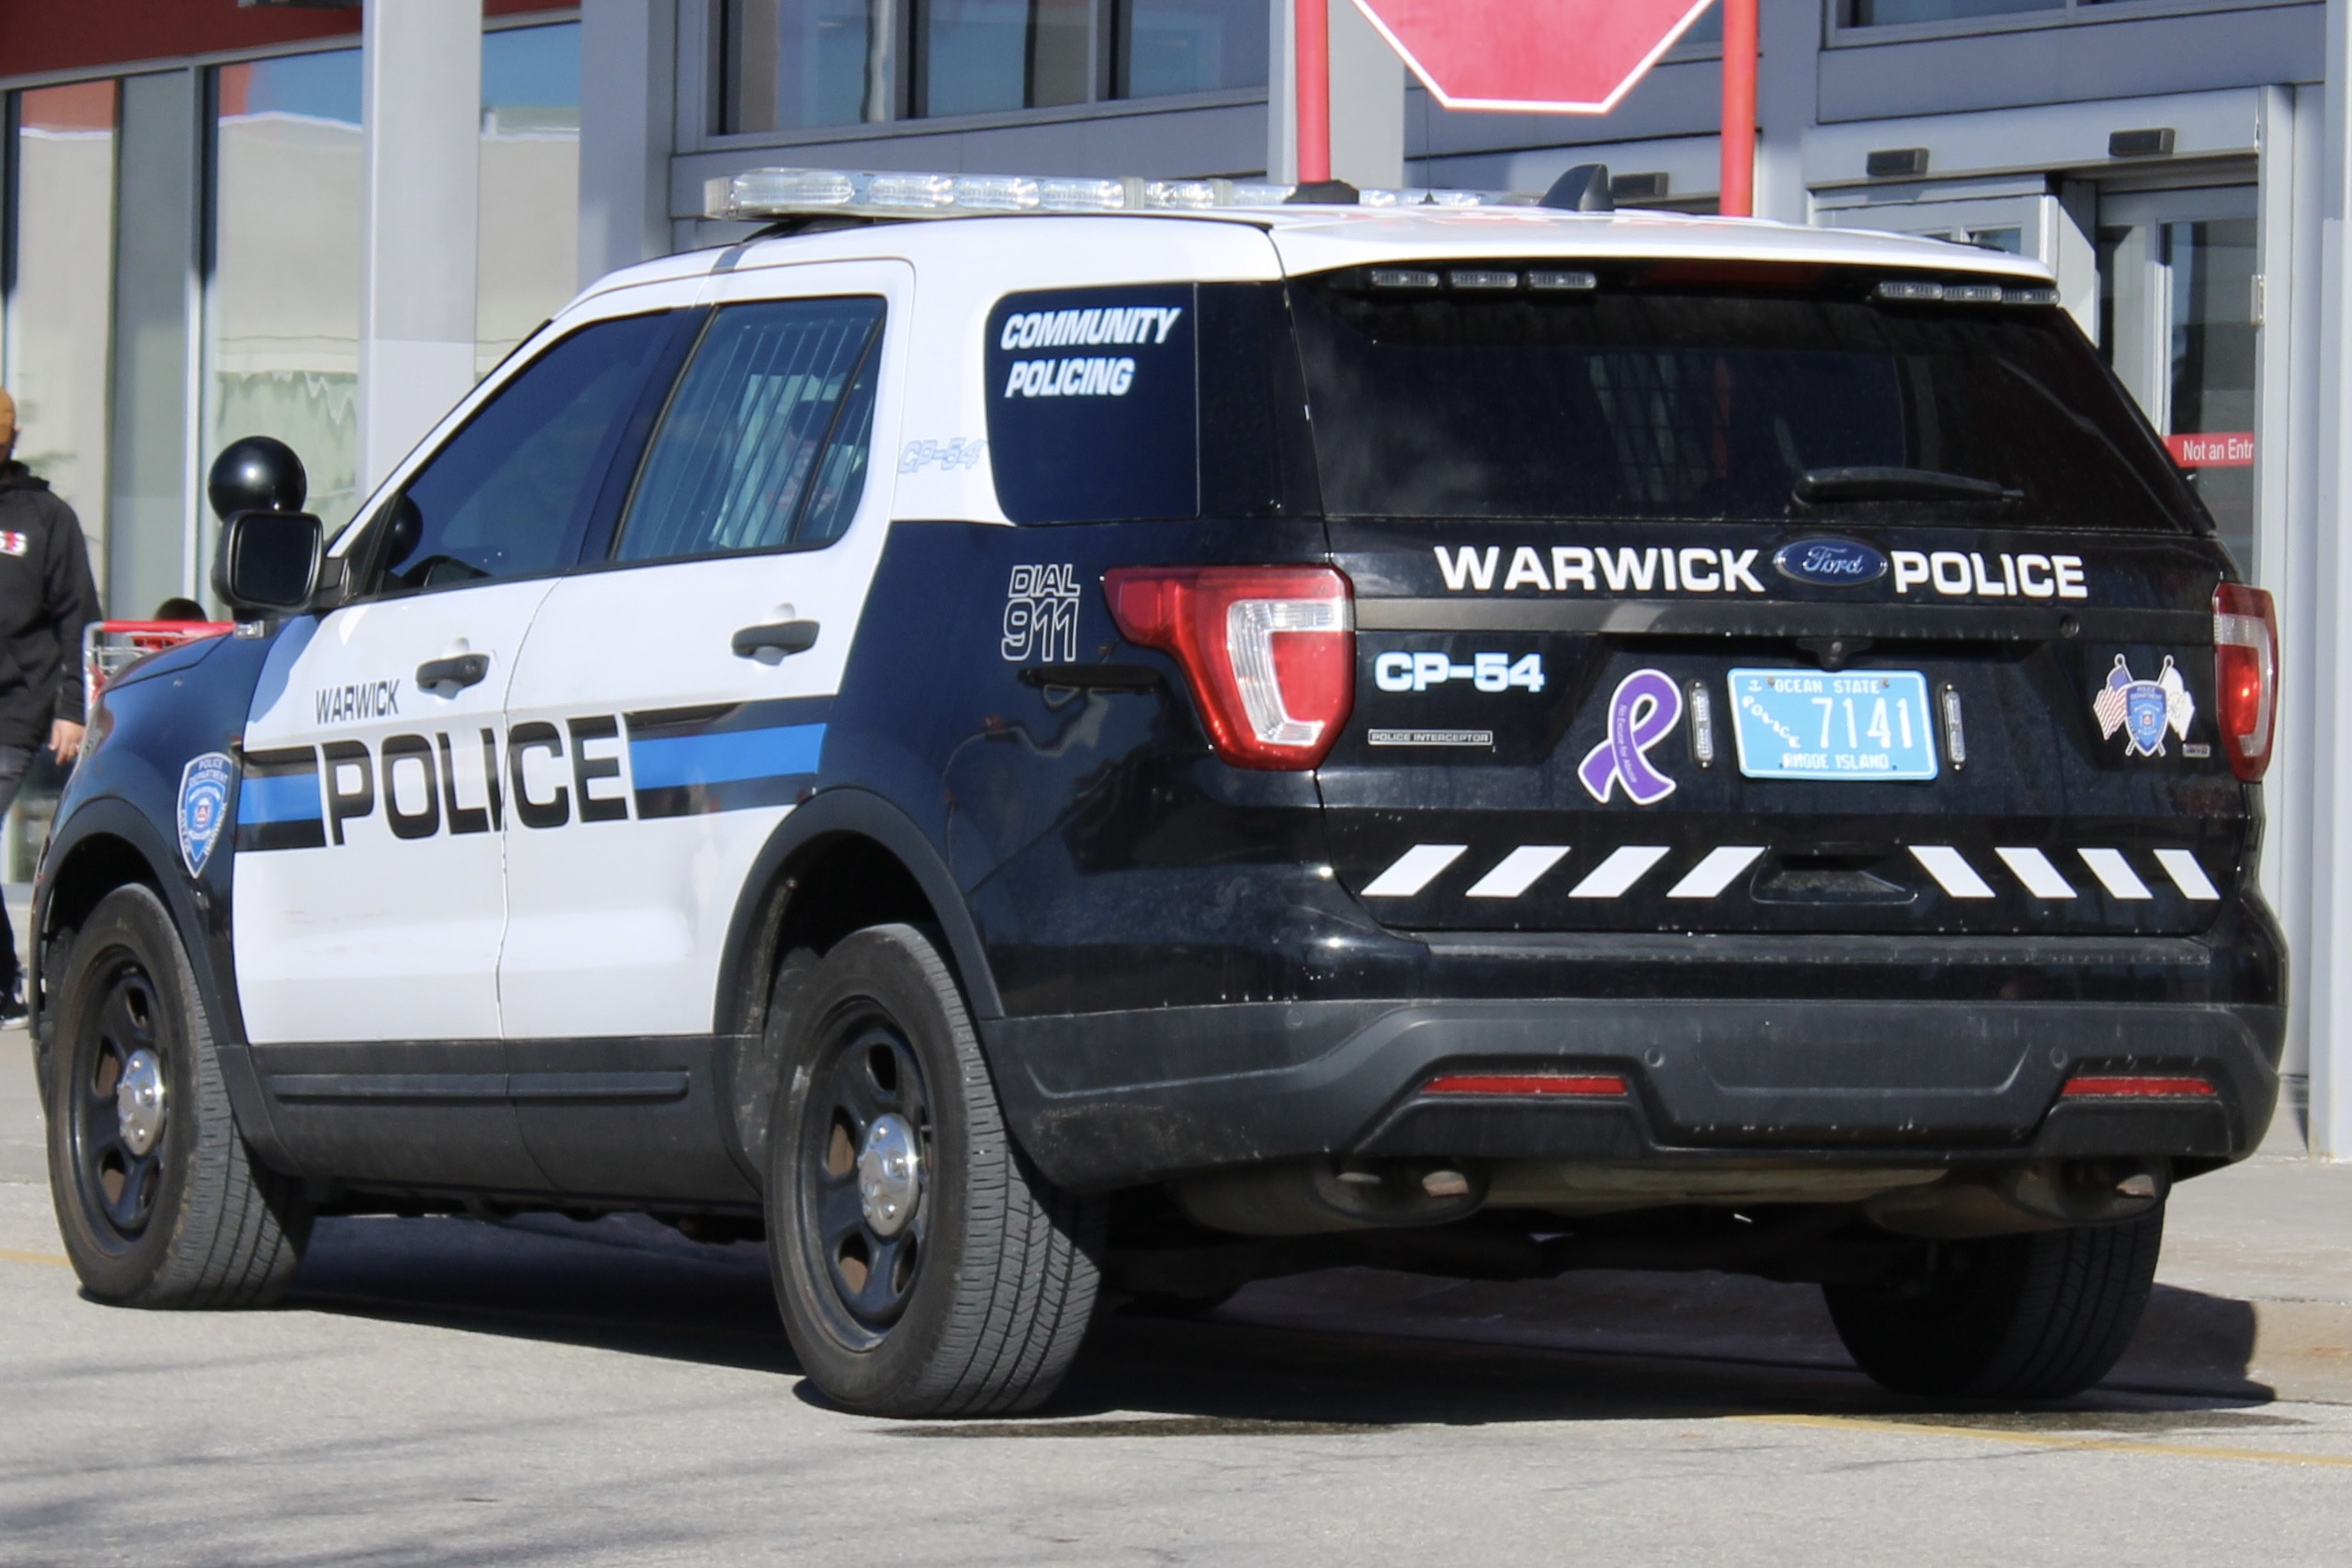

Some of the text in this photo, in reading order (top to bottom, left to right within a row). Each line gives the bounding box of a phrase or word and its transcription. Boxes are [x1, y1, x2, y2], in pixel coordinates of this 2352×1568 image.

[1000, 307, 1183, 350] COMMUNITY
[1004, 357, 1136, 398] POLICING
[898, 436, 988, 475] CP-54
[2183, 440, 2206, 462] Not
[2209, 442, 2225, 461] an
[1008, 564, 1081, 598] DIAL
[1433, 546, 1766, 593] WARWICK
[1802, 545, 1864, 576] Ford
[1890, 550, 2089, 599] POLICE
[1001, 597, 1080, 663] 911
[1374, 651, 1546, 694] CP-54
[1774, 679, 1880, 695] OCEAN STATE
[315, 678, 401, 725] WARWICK
[1742, 696, 1801, 748] POLICE
[1811, 696, 1913, 749] 7141
[1372, 733, 1489, 742] POLICE INTERCEPTOR
[199, 757, 224, 770] POLICE
[320, 714, 628, 846] POLICE
[1782, 753, 1889, 769] RHODE ISLAND
